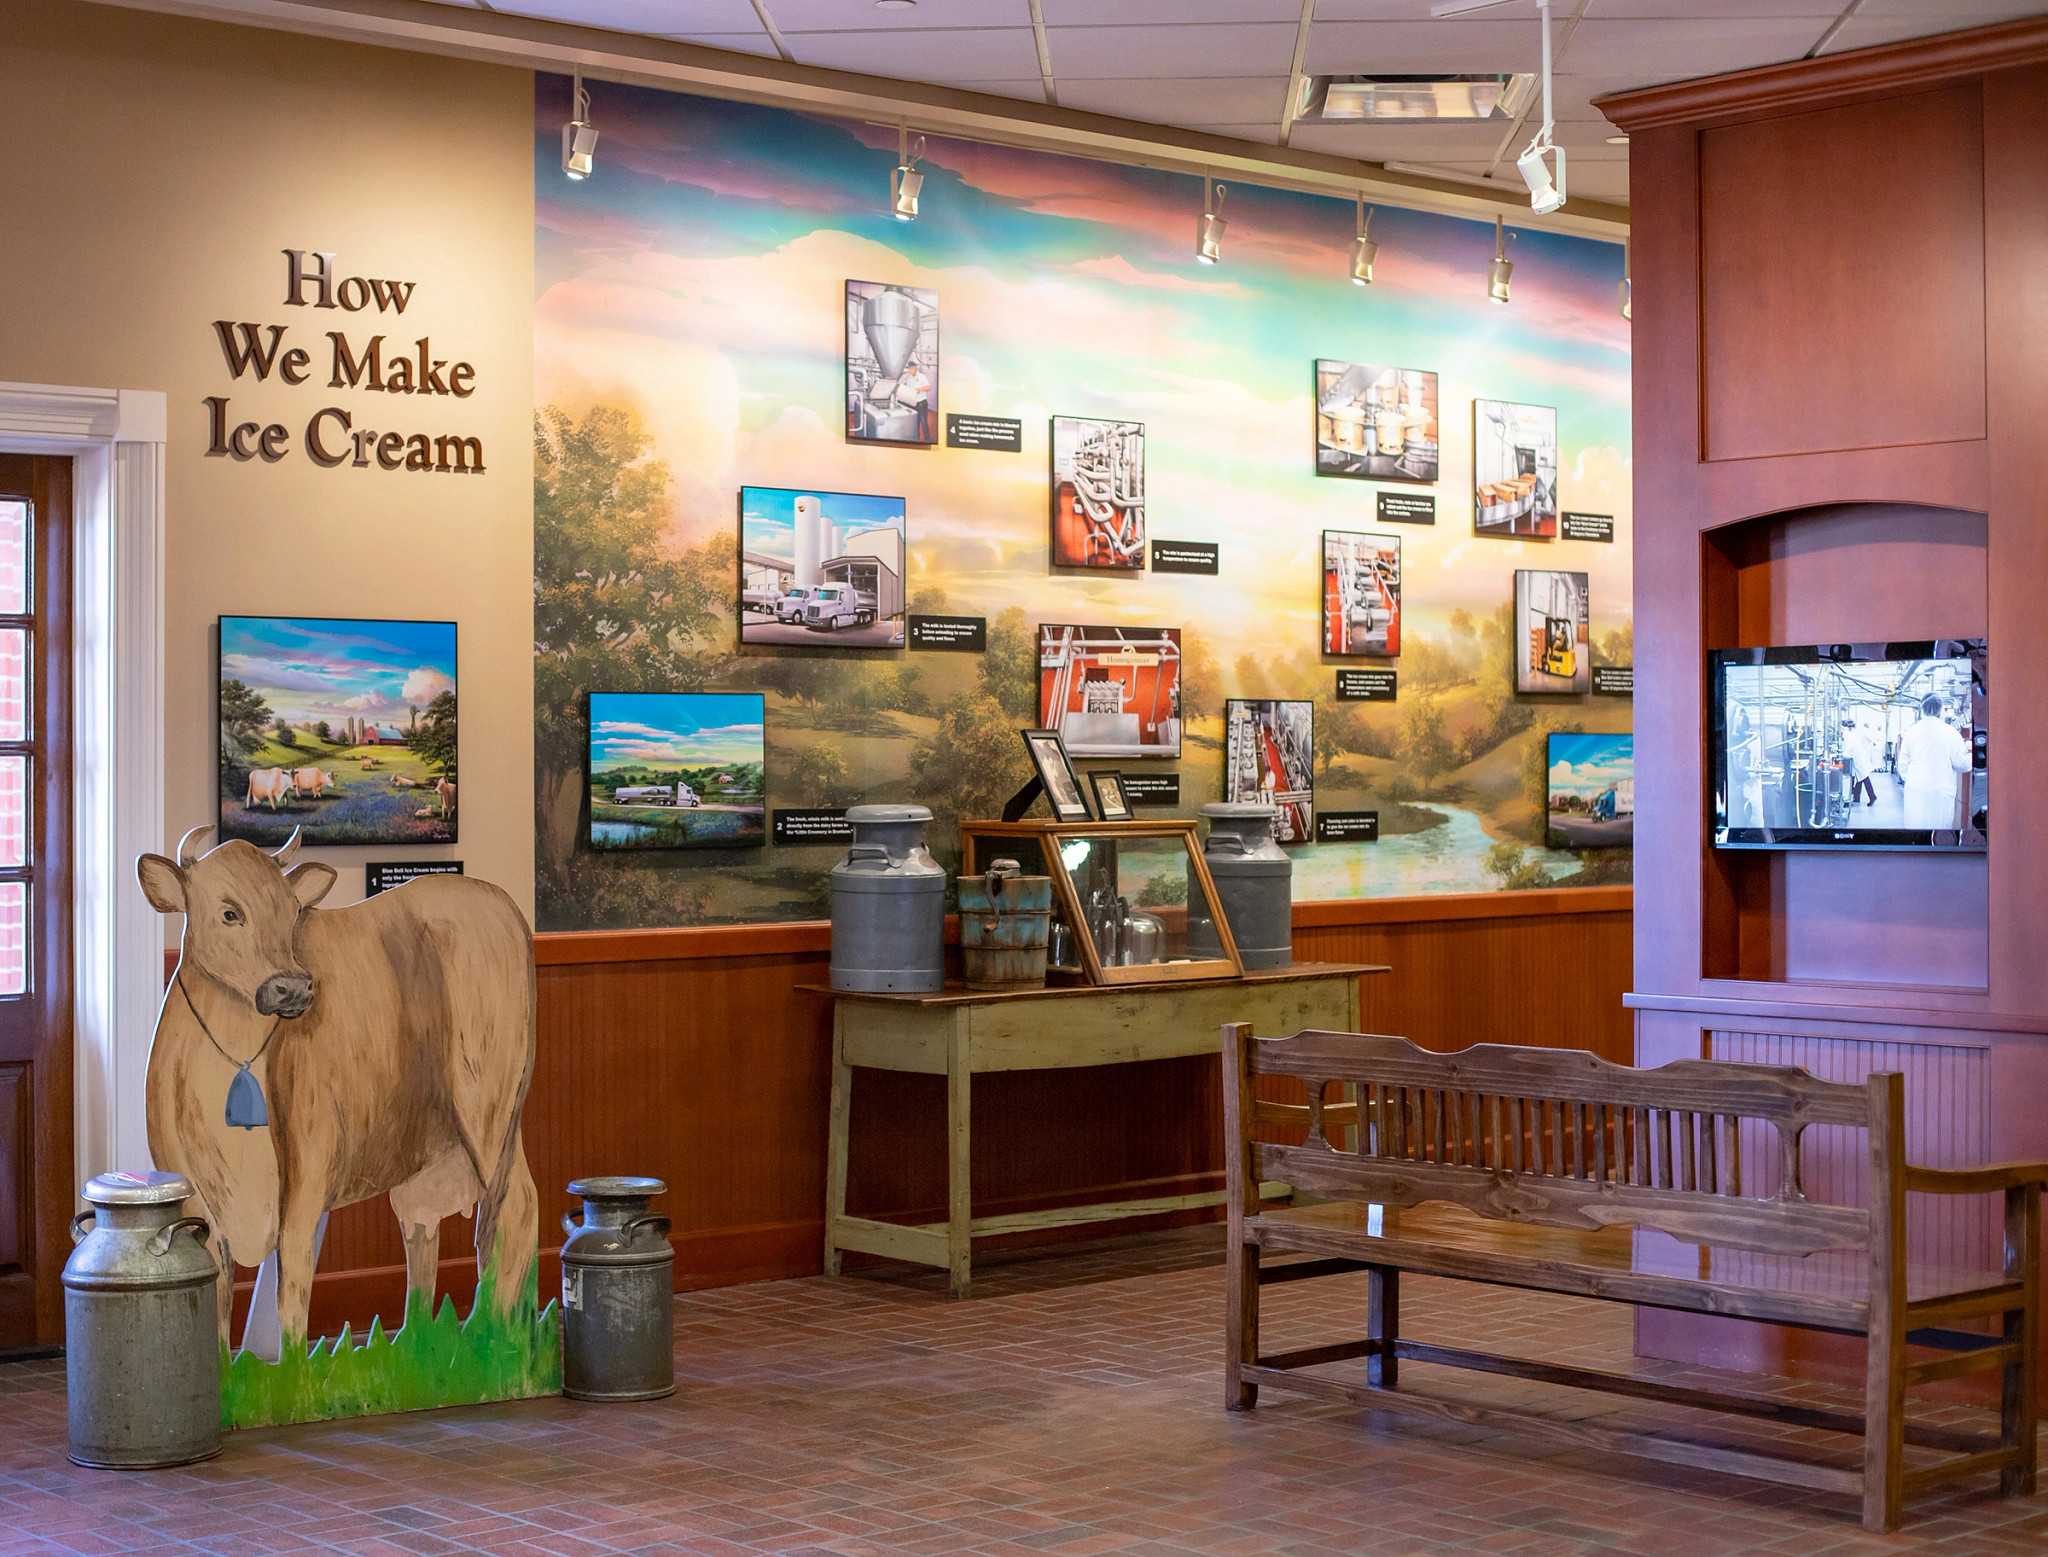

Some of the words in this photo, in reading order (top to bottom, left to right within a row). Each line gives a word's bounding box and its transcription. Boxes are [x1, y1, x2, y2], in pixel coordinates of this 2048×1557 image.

[281, 248, 417, 315] How
[211, 320, 311, 385] We
[325, 331, 476, 398] Make
[204, 396, 290, 463] Ice
[304, 407, 487, 475] Cream
[371, 877, 377, 886] 1
